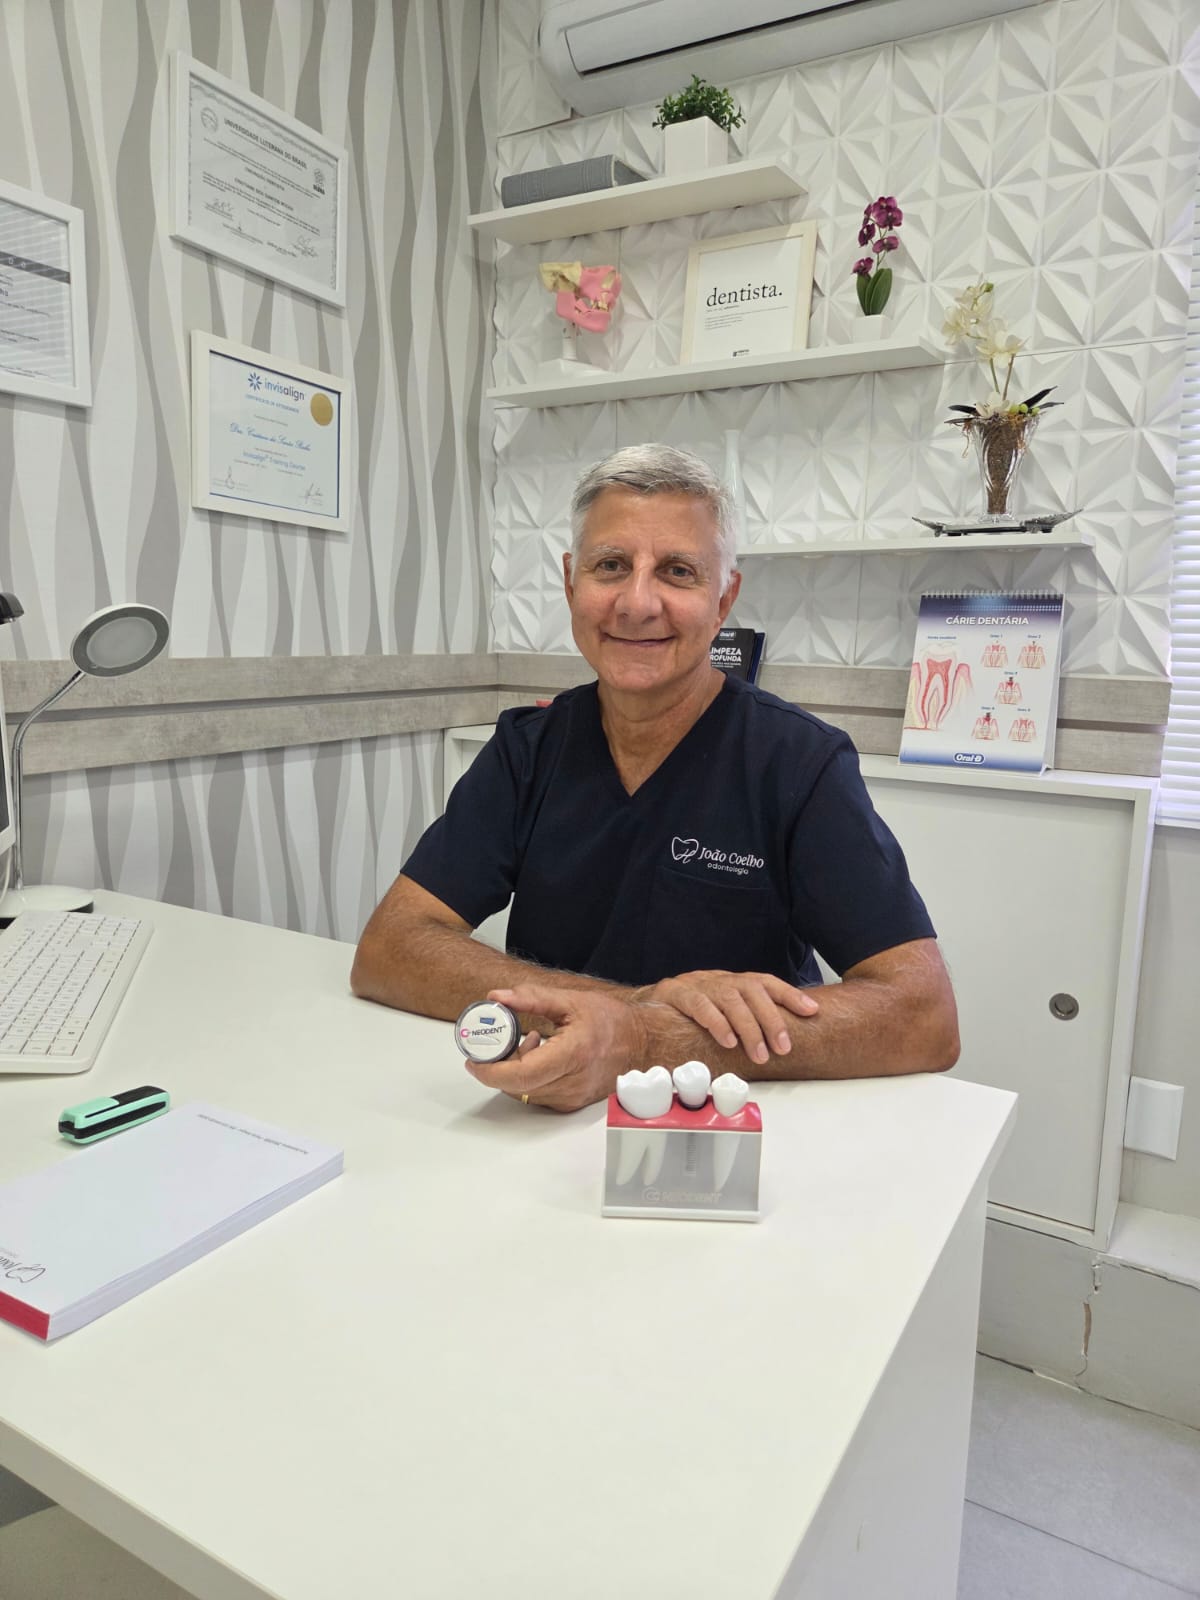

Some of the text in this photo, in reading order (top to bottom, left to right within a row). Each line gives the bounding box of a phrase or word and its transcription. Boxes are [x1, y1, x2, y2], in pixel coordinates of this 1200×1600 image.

[224, 118, 259, 142] UNIVERSIDADE
[259, 136, 284, 156] LUTERANA
[284, 152, 292, 160] DO
[291, 155, 308, 169] BRASIL
[706, 283, 782, 307] dentista.
[264, 378, 304, 401] invisalign
[945, 615, 1030, 625] CÁRIE DENTÁRIA
[956, 754, 982, 762] Oral-B
[698, 847, 764, 868] João Coelho
[707, 862, 749, 876] odontologia
